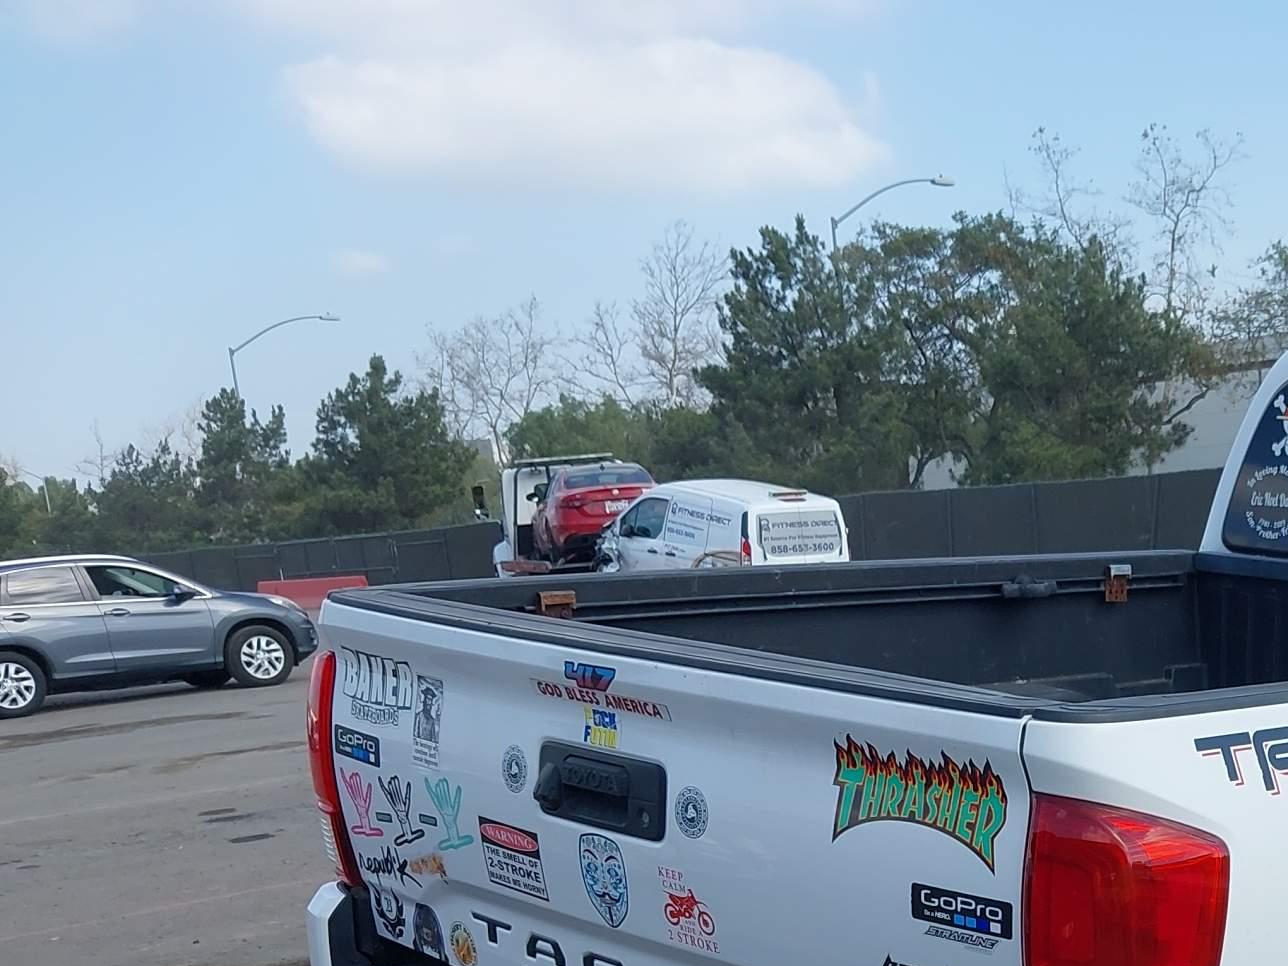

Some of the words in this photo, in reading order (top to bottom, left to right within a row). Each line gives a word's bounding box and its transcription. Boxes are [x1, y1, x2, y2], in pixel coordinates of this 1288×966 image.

[340, 645, 413, 711] BAKER
[564, 660, 616, 692] 417
[536, 681, 563, 698] GOD
[565, 687, 601, 706] BLESS
[604, 694, 664, 720] AMERICA
[337, 729, 376, 752] GoPro
[831, 734, 1008, 876] THRASHER
[485, 825, 533, 850] WARNING
[485, 845, 502, 857] THE
[502, 851, 527, 866] SMELL
[528, 859, 539, 869] OF
[488, 856, 542, 884] 2-STROKE
[657, 866, 684, 882] KEEP
[662, 880, 687, 894] CALM
[920, 889, 1003, 921] GoPro
[668, 929, 674, 941] 2
[677, 931, 721, 954] STROKE
[924, 925, 999, 950] STRAITLINE
